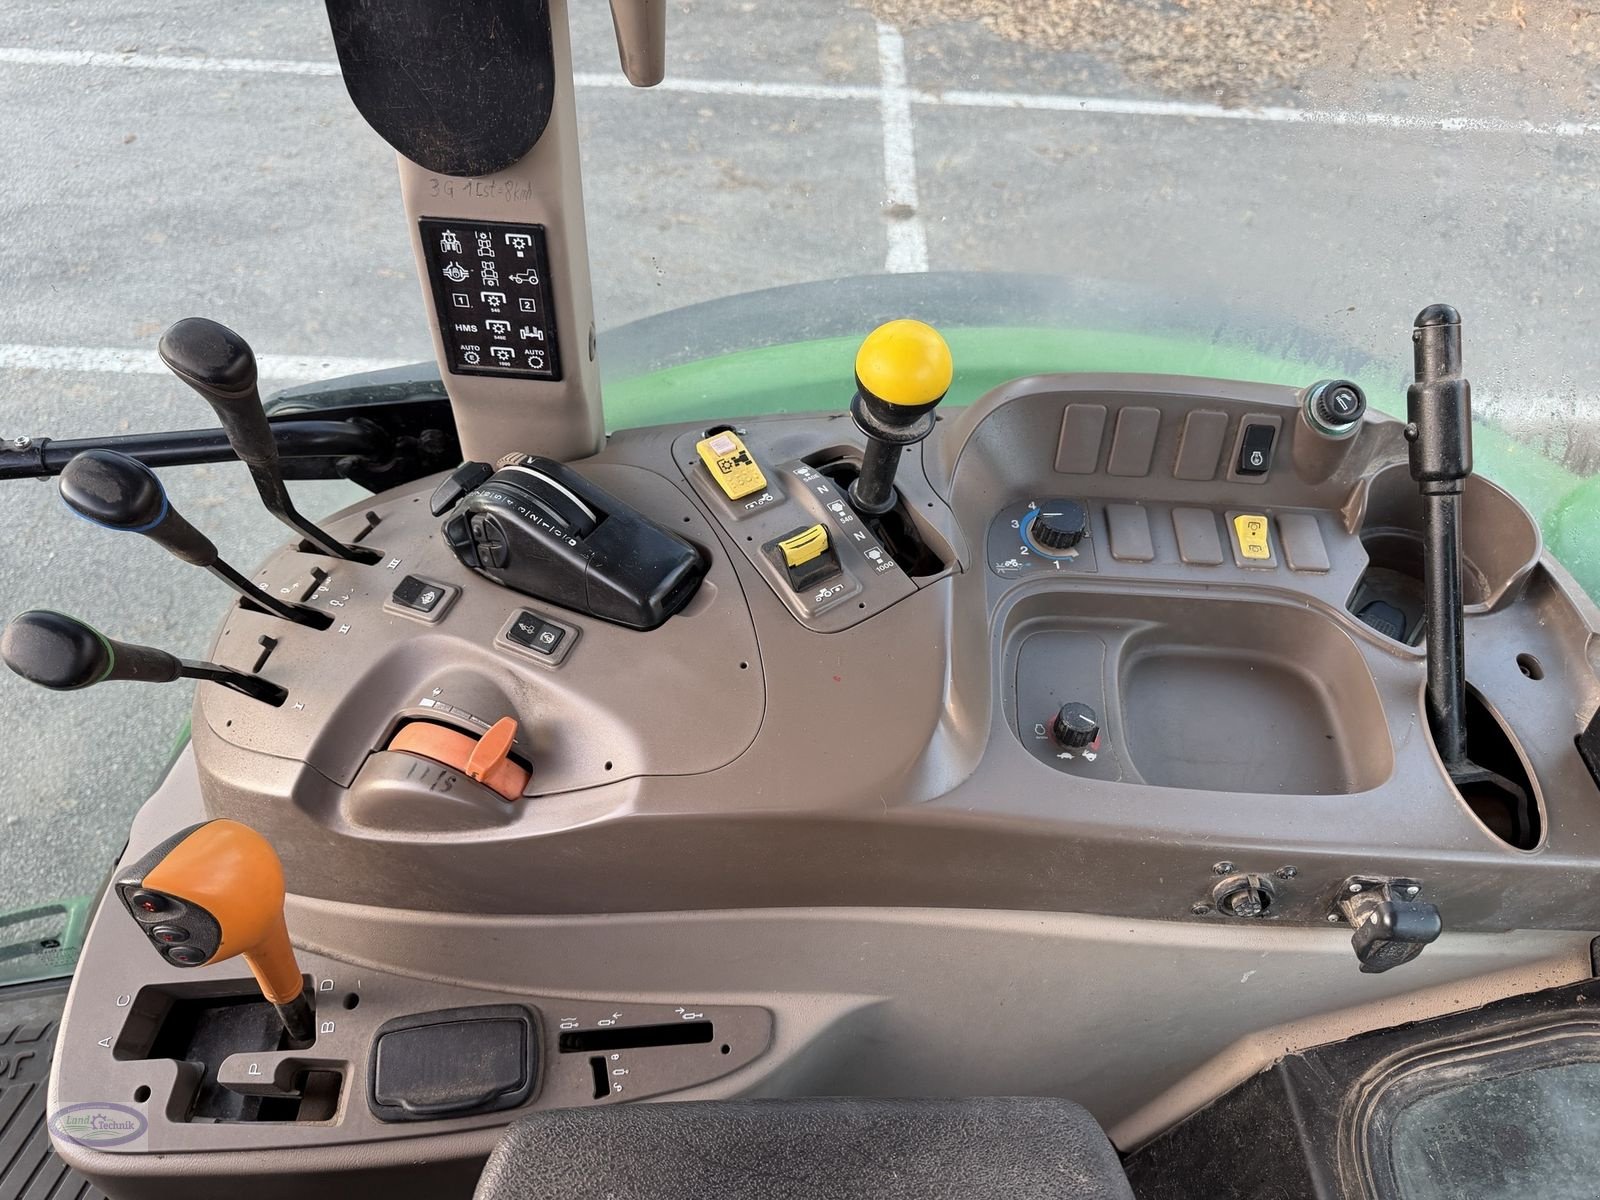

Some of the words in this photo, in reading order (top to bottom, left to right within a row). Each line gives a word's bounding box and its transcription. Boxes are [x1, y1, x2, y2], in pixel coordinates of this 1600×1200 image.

[455, 324, 478, 333] HMS
[460, 344, 481, 352] AUTO
[816, 485, 829, 494] N
[1028, 501, 1037, 510] 4
[840, 515, 854, 524] 540
[1011, 519, 1020, 529] 3
[853, 531, 866, 541] N
[1020, 546, 1029, 555] 2
[875, 561, 894, 573] 1000
[1053, 560, 1060, 569] 1
[320, 978, 334, 992] D
[116, 994, 131, 1008] C
[321, 1021, 335, 1034] B
[97, 1036, 113, 1048] A
[248, 1063, 262, 1075] P
